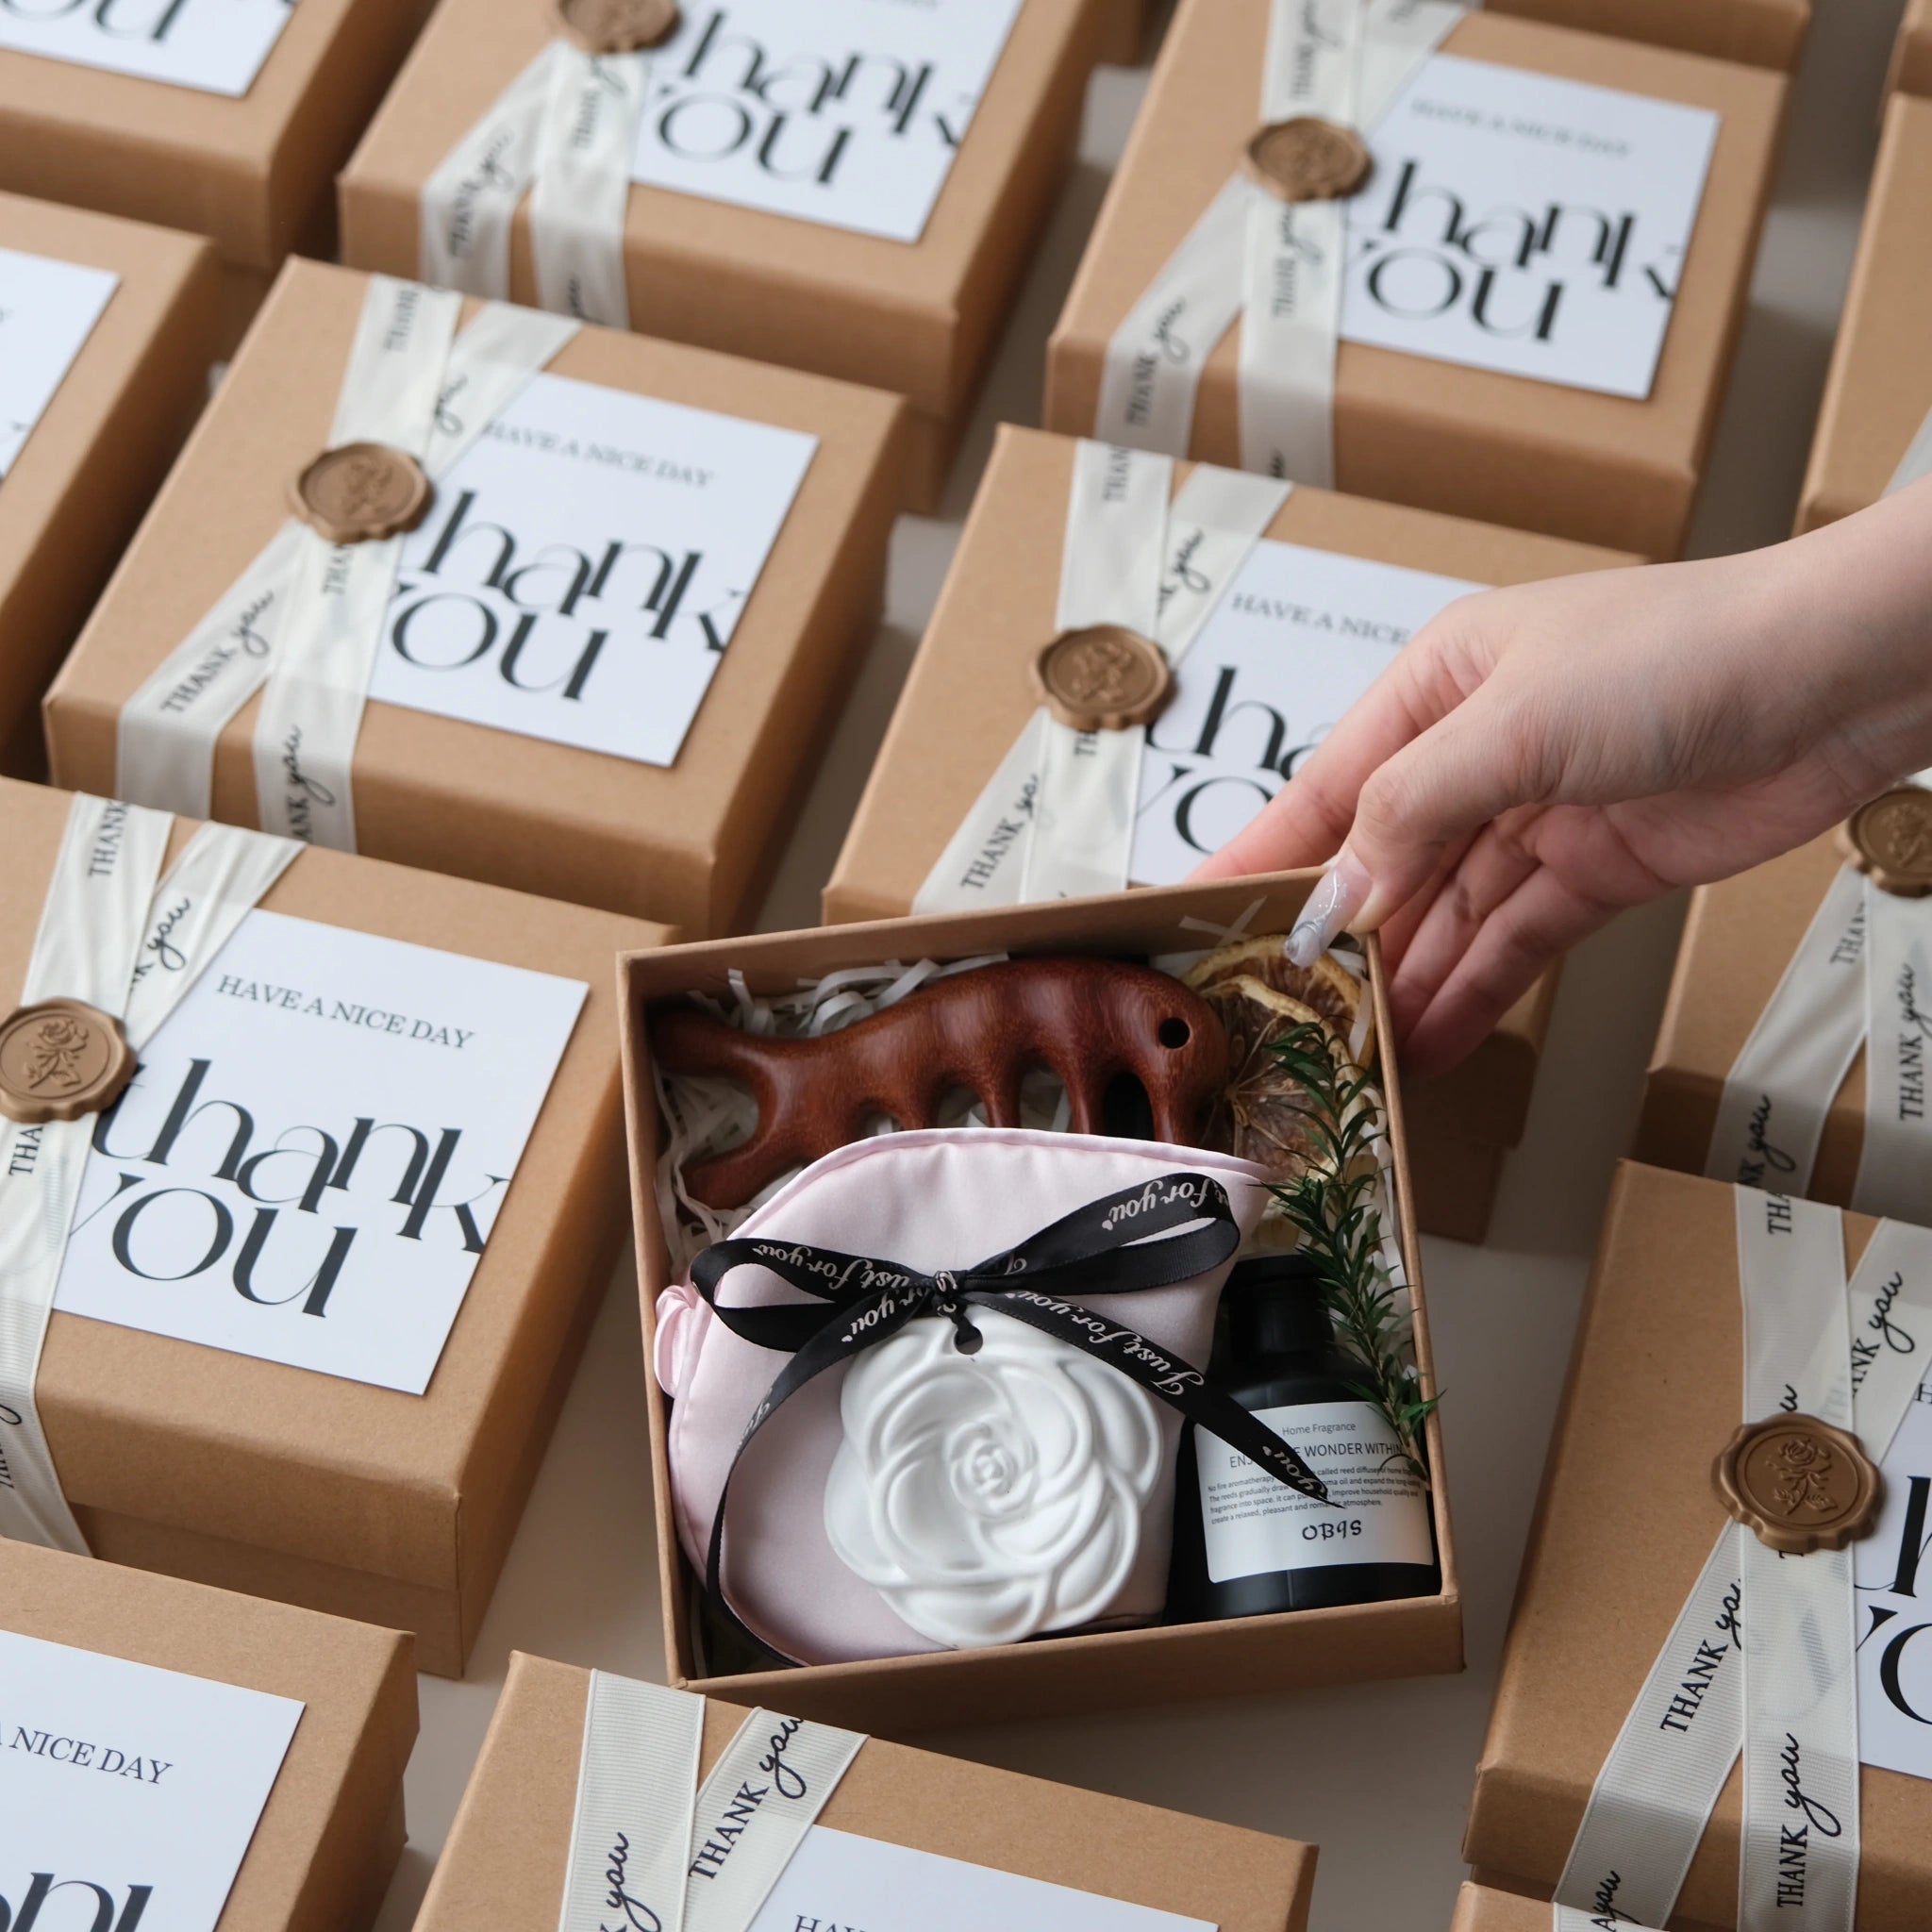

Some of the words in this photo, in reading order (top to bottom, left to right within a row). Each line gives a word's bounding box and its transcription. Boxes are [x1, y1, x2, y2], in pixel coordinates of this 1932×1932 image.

[420, 489, 745, 654] hank
[1232, 591, 1312, 626] HAVE
[1313, 611, 1334, 631] A
[158, 643, 238, 713] THANK
[229, 589, 276, 658] you
[959, 818, 1025, 890] THANK
[147, 898, 192, 971] you
[216, 974, 302, 1011] HAVE
[303, 995, 325, 1017] A
[330, 1000, 408, 1036] NICE
[408, 1018, 476, 1050] DAY
[1900, 1034, 1924, 1122] THANK
[859, 1269, 911, 1290] ust
[1869, 1271, 1916, 1355] you
[1122, 1338, 1206, 1396] Just
[1282, 1426, 1310, 1436] Home
[1312, 1423, 1357, 1435] Fragrance
[1304, 1443, 1362, 1457] WONDER
[1364, 1442, 1404, 1455] WITHIN
[1210, 1503, 1238, 1514] fragrance
[1332, 1489, 1360, 1498] improve
[1211, 1516, 1229, 1525] create
[1262, 1504, 1292, 1516] pleasant
[1293, 1502, 1308, 1510] and
[1221, 1491, 1238, 1500] reeds
[1239, 1486, 1271, 1499] gradually
[1363, 1477, 1385, 1486] expand
[1227, 1475, 1275, 1489] aromatherapy
[1659, 1639, 1728, 1732] THANK
[8, 1726, 96, 1767] NICE
[96, 1747, 174, 1784] DAY
[1780, 1732, 1842, 1838] you
[688, 1781, 770, 1879] THANK
[758, 1717, 807, 1800] you
[606, 1831, 661, 1932] you
[1776, 1824, 1808, 1908] THANK
